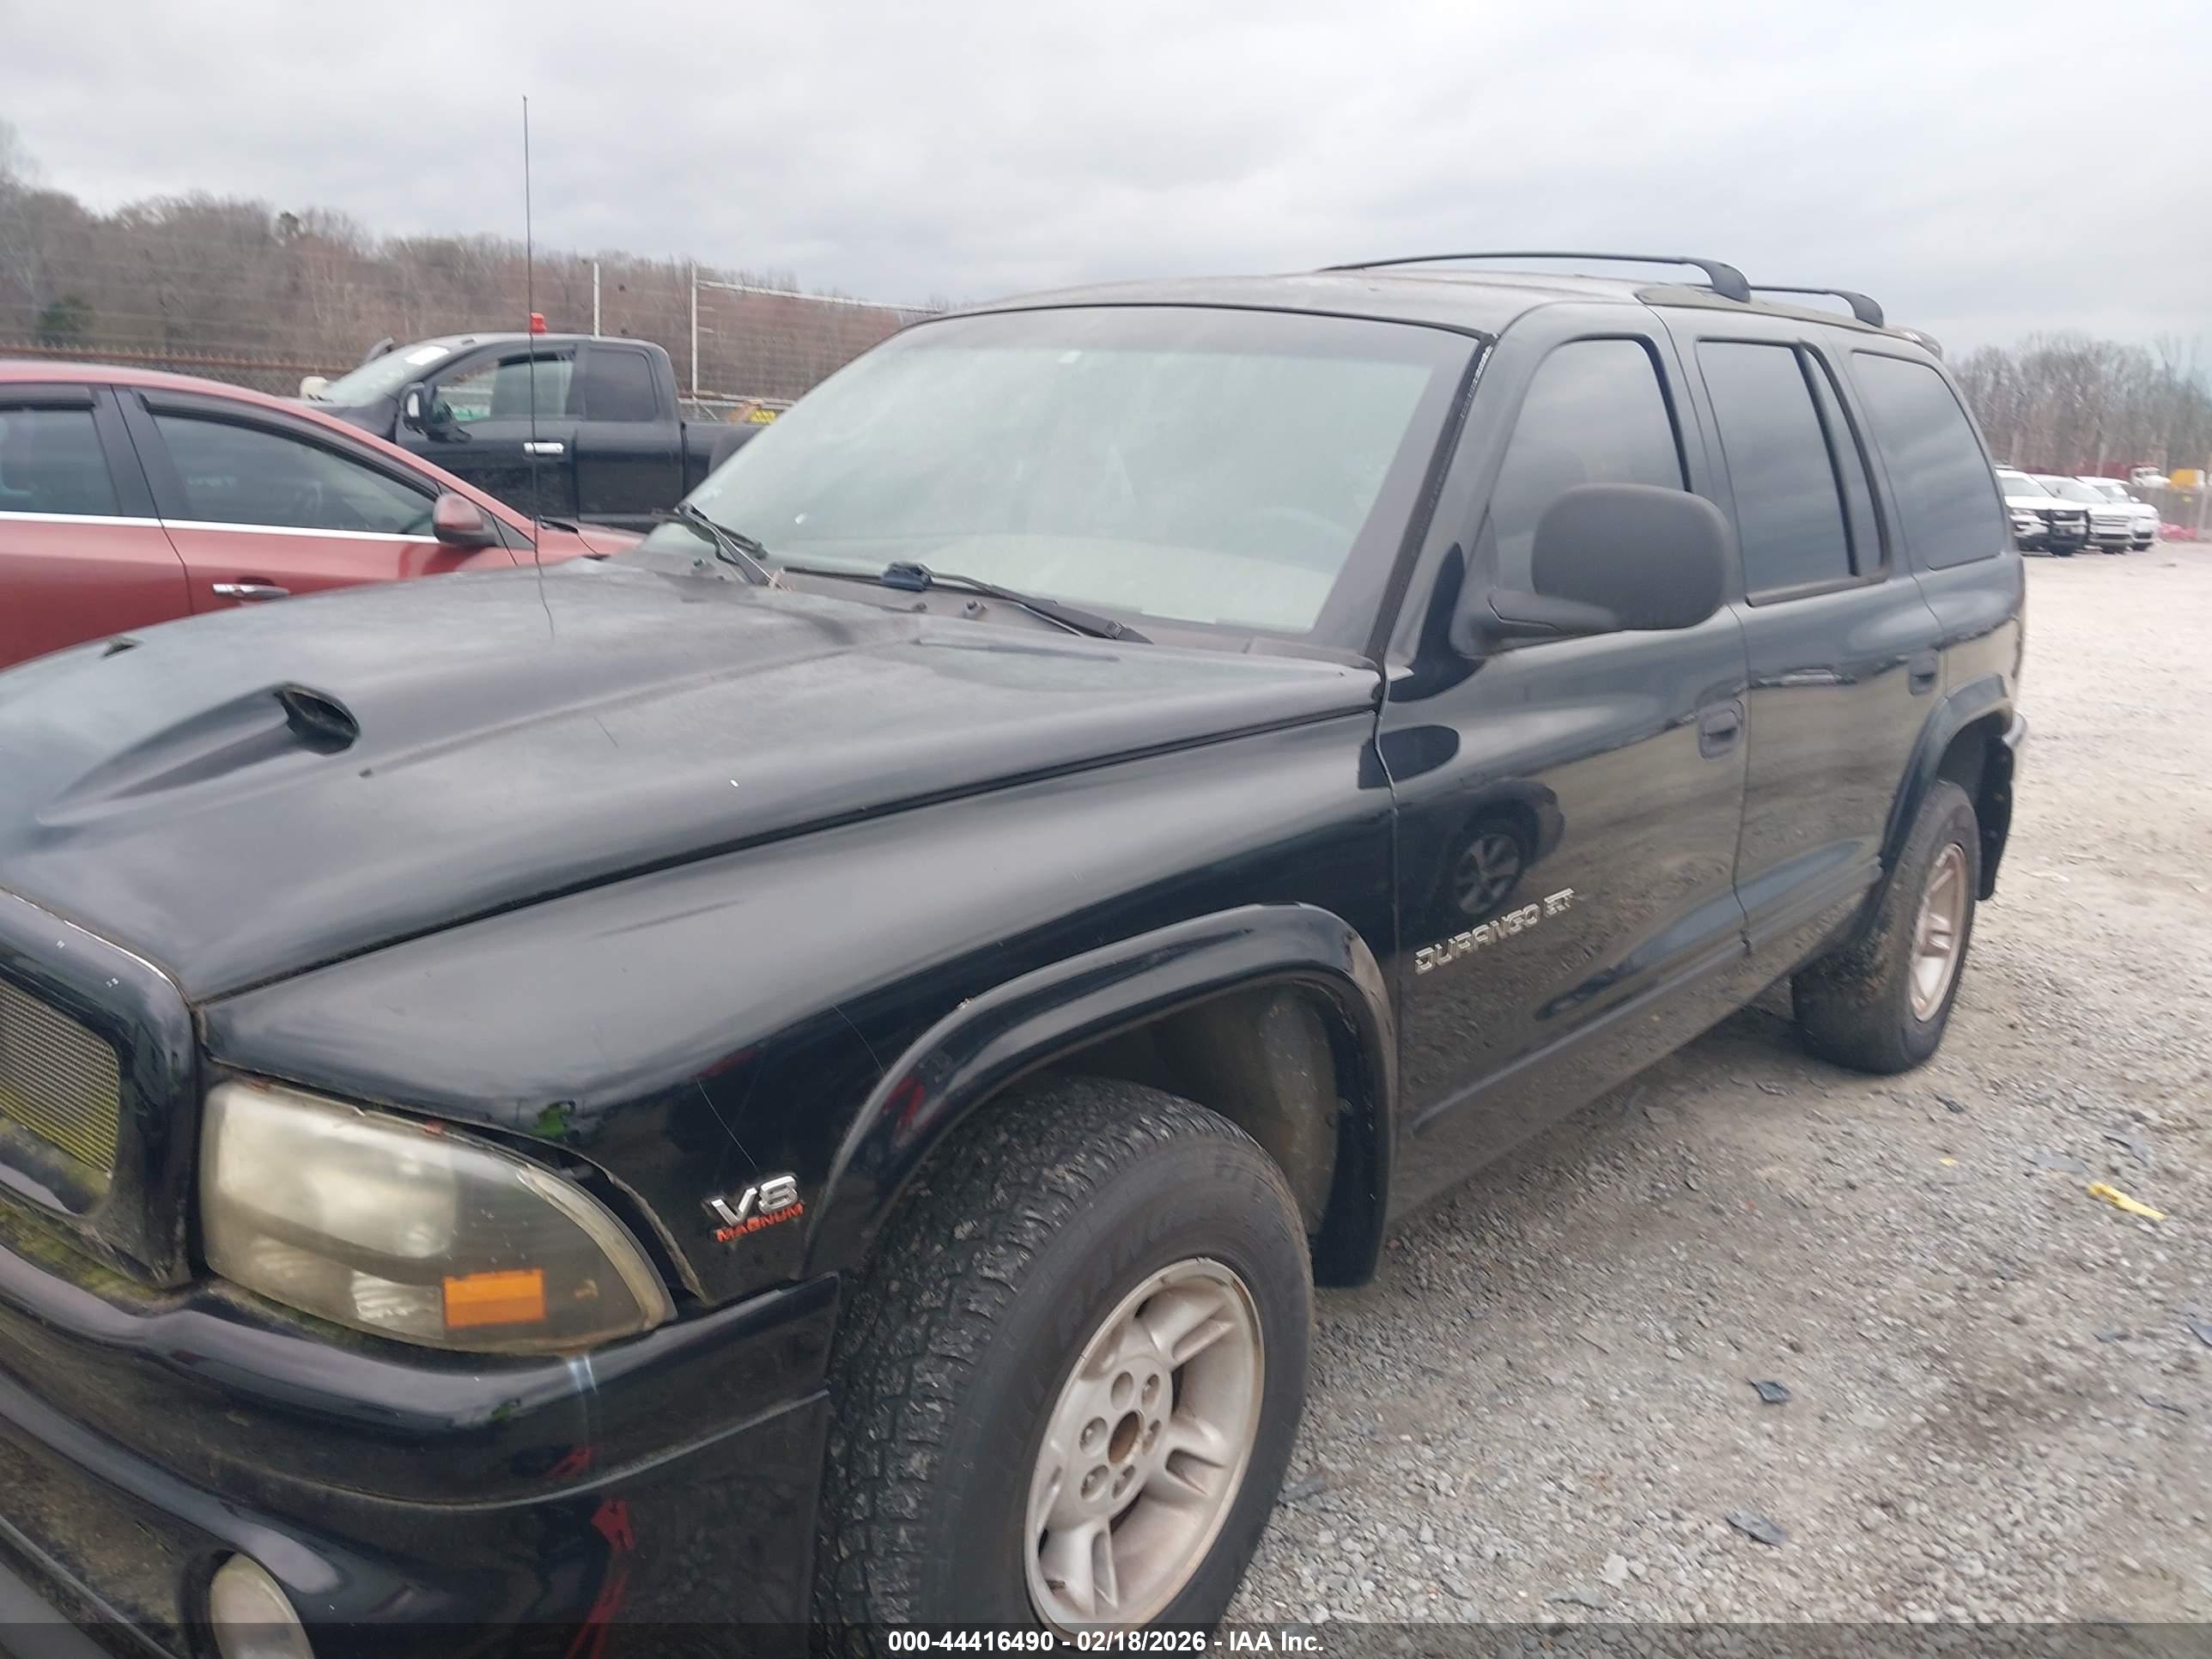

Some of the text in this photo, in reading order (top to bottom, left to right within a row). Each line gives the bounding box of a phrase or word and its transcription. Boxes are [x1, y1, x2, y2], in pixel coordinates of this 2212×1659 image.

[1414, 903, 1540, 974] DURANGO
[711, 1176, 799, 1227] V8
[716, 1203, 805, 1243] MAGNUM
